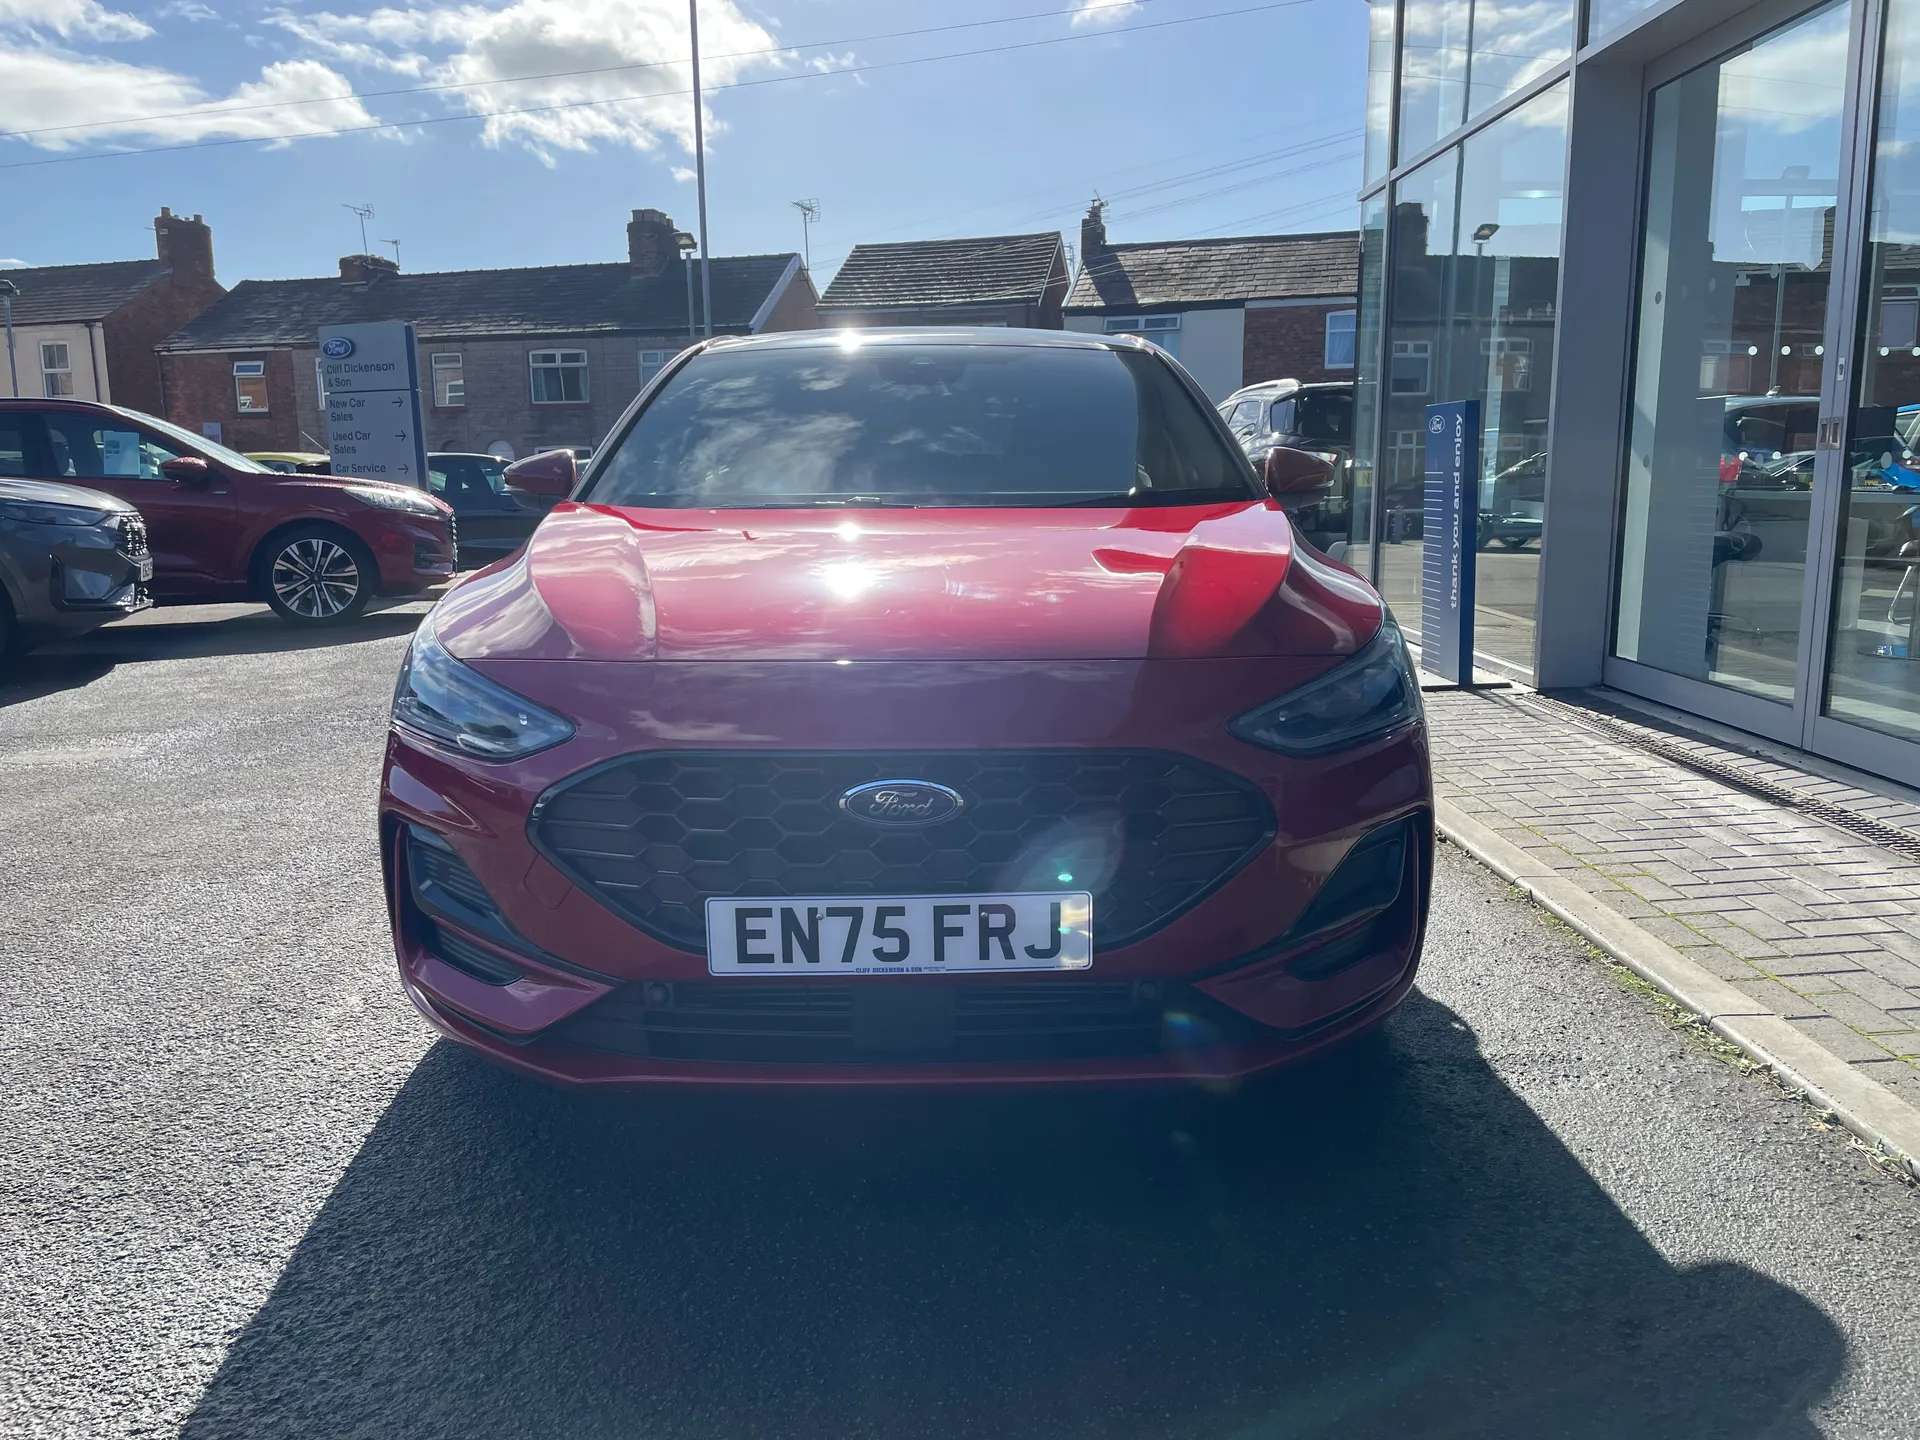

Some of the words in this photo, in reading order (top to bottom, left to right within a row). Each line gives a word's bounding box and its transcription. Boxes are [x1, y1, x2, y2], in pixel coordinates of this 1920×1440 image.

[327, 364, 342, 375] Cliff
[344, 362, 395, 373] Dickenson
[328, 378, 334, 388] &
[335, 377, 352, 387] Son
[329, 399, 348, 409] New
[350, 398, 366, 408] Car
[331, 411, 354, 421] Sales
[332, 431, 353, 441] Used
[354, 430, 371, 441] Car
[334, 444, 357, 455] Sales
[335, 463, 350, 473] Car
[351, 463, 386, 473] Service
[1450, 553, 1458, 609] thank
[1454, 413, 1462, 468] enjoy
[734, 905, 911, 964] EN75
[932, 901, 1062, 962] FRJ
